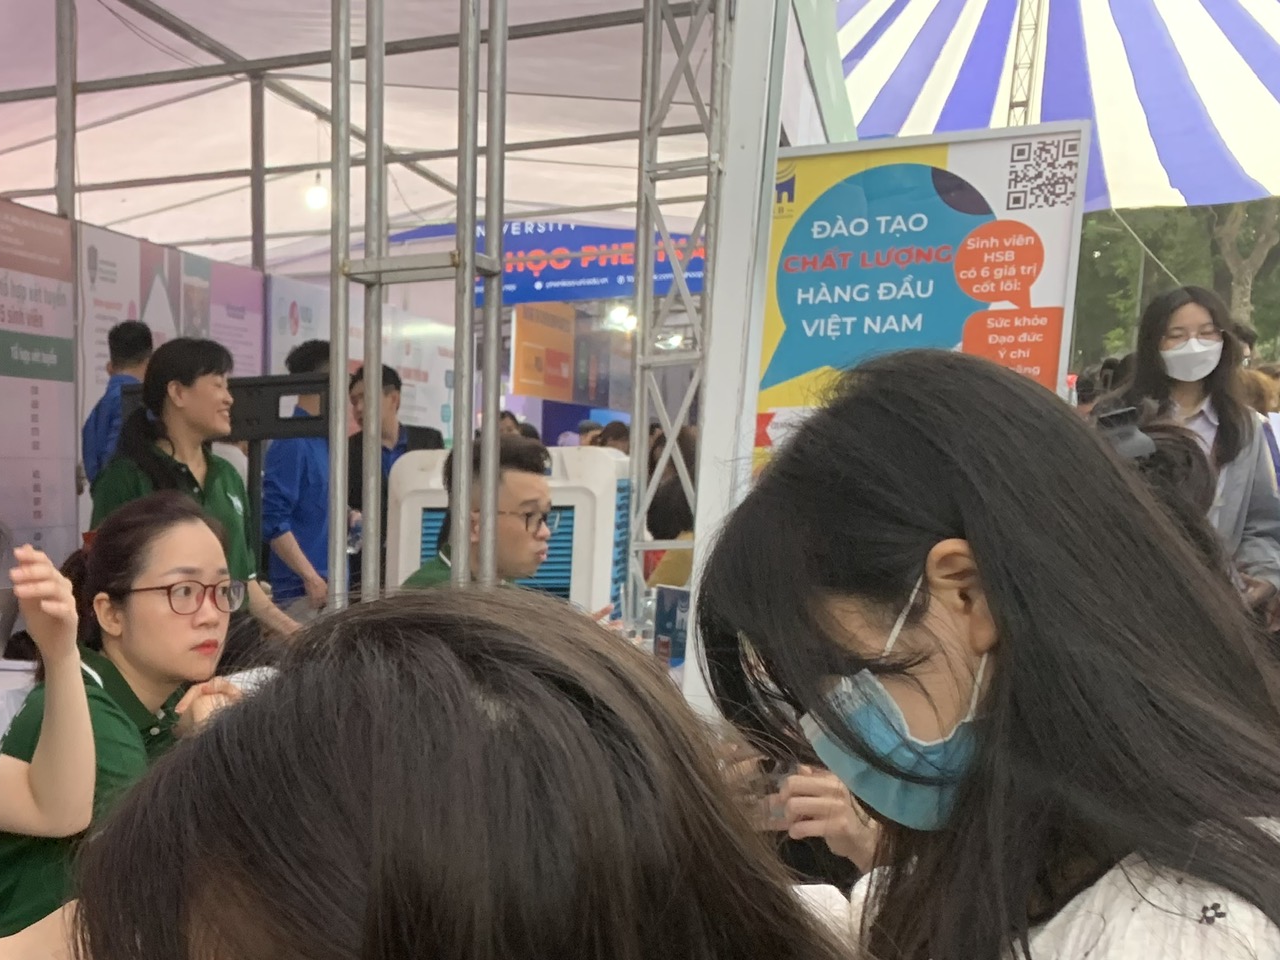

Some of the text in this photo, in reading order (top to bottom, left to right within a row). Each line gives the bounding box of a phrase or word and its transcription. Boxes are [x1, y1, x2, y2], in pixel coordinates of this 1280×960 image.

[811, 213, 928, 239] ĐÀO TẠO
[966, 234, 1035, 250] Sinh viên
[783, 243, 954, 274] CHẤT LƯỢNG
[984, 250, 1015, 263] HSB
[959, 263, 1037, 280] có 6 giá trị
[796, 274, 934, 306] HÀNG ĐẦU
[972, 280, 996, 293] cốt
[801, 313, 923, 341] VIỆT NAM
[986, 317, 1011, 329] Sức
[988, 334, 1015, 345] Đạo
[1008, 363, 1041, 375] ăng
